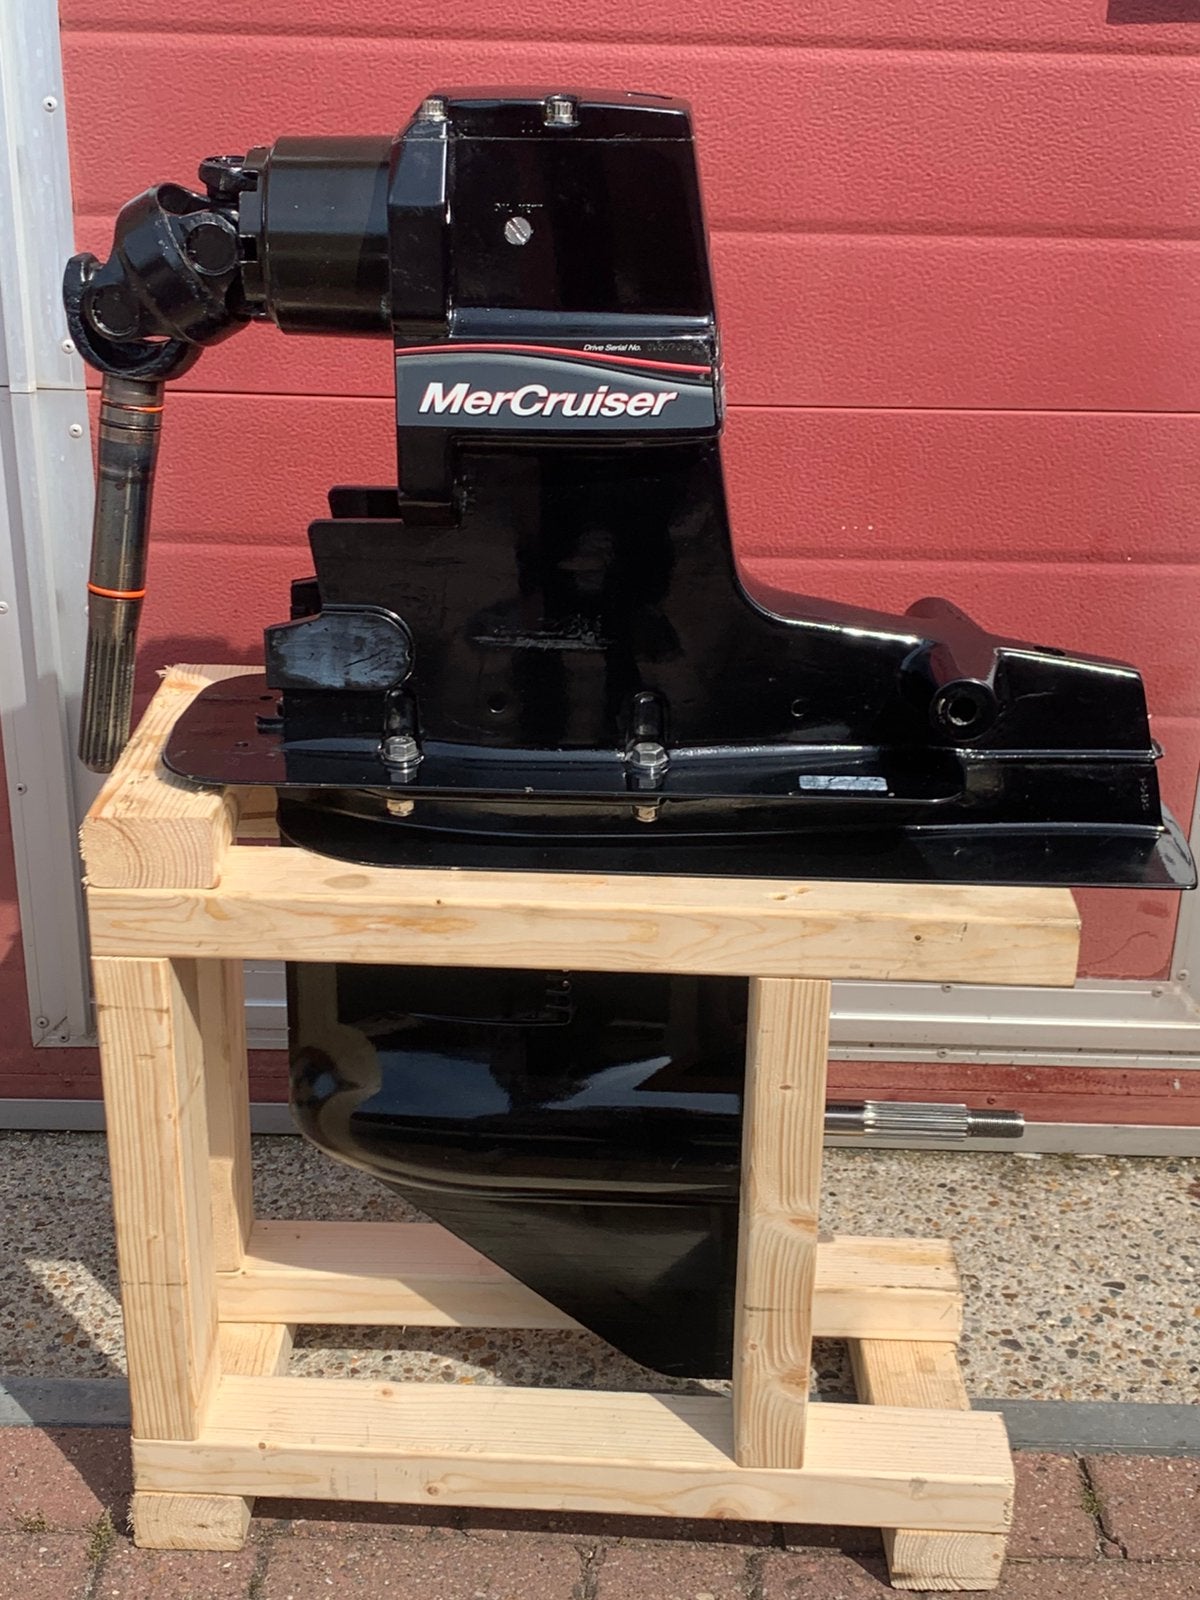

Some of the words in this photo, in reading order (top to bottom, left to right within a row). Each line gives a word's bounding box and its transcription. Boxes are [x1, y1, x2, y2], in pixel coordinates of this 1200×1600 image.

[583, 343, 604, 351] Drive
[605, 343, 628, 351] Serial
[628, 343, 641, 351] No.
[418, 382, 678, 418] MerCruiser
